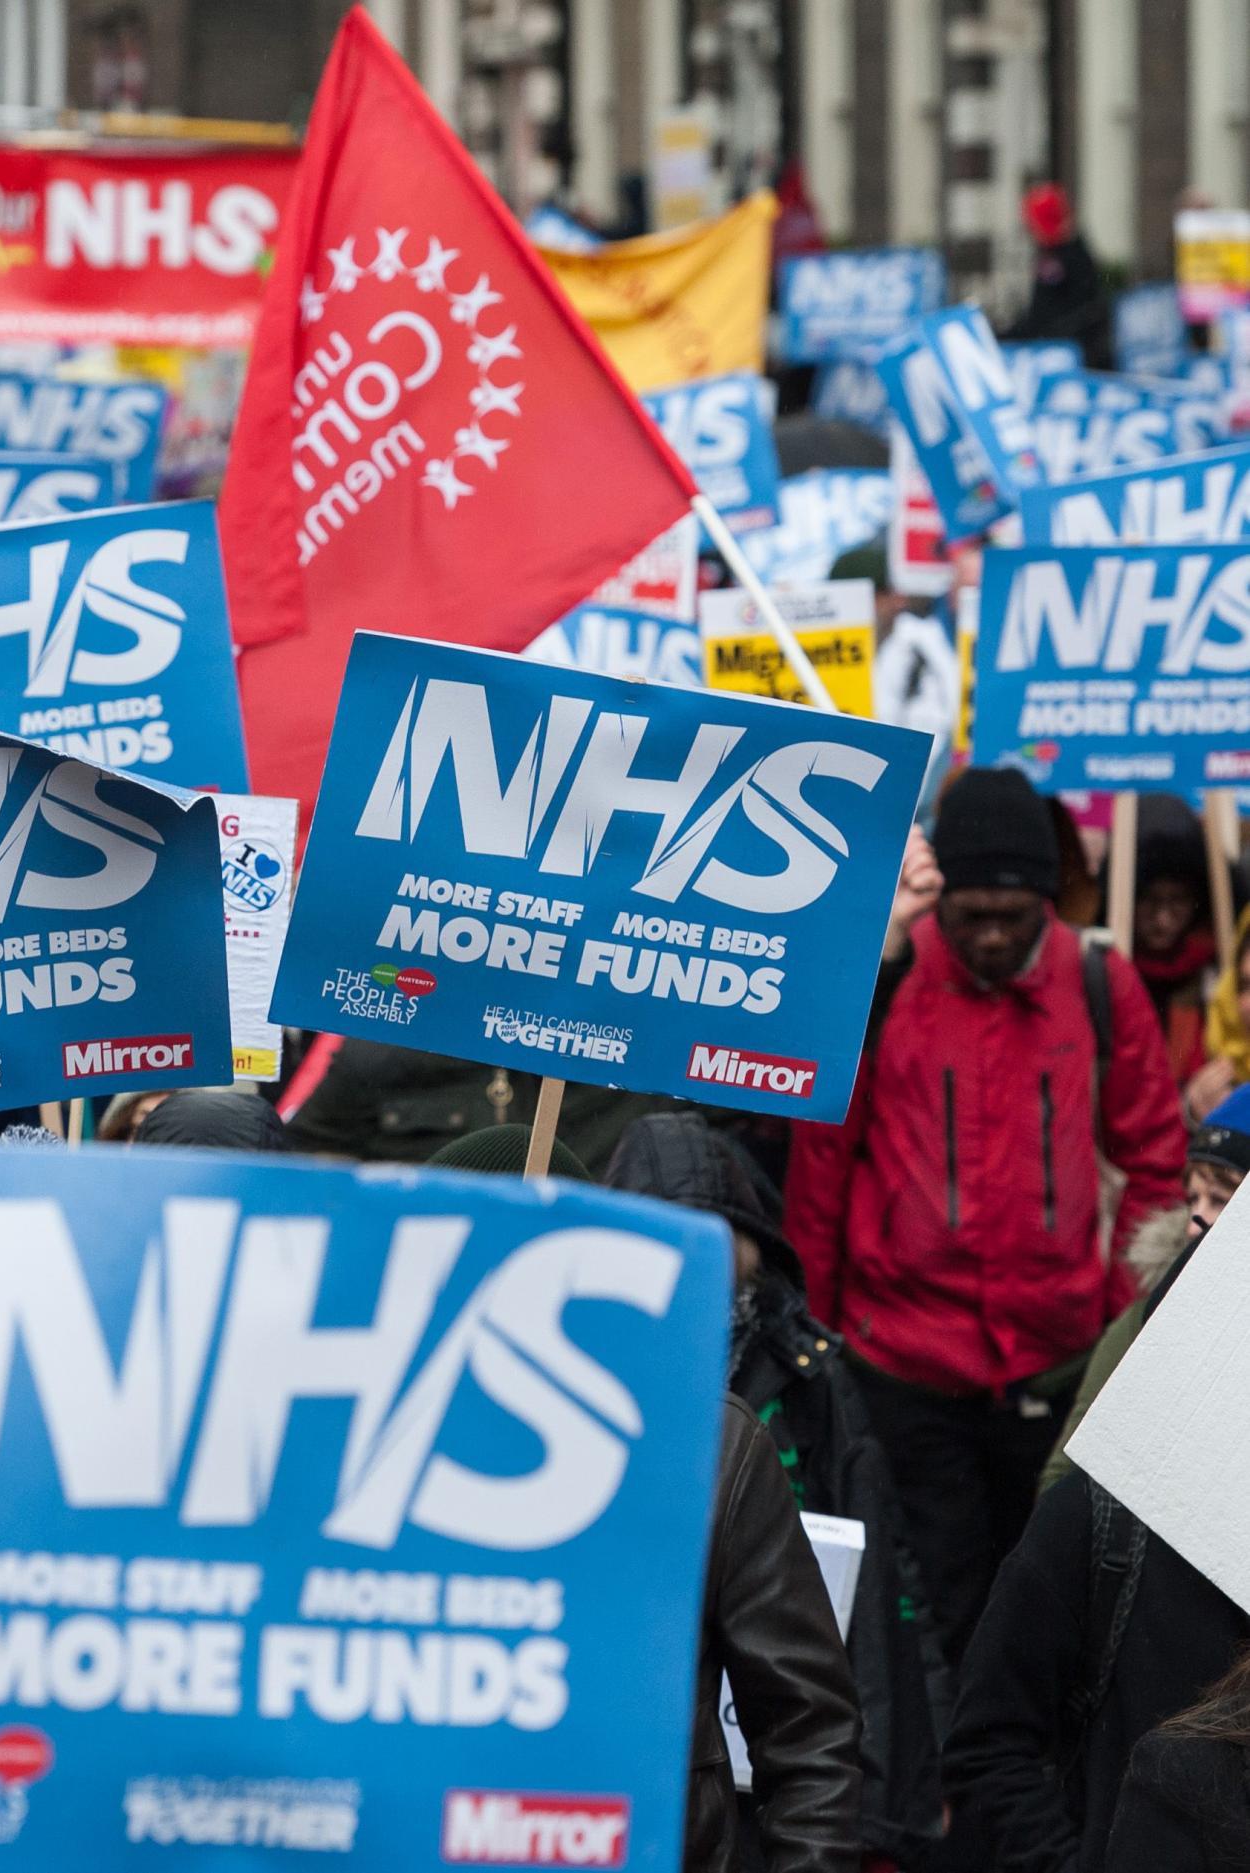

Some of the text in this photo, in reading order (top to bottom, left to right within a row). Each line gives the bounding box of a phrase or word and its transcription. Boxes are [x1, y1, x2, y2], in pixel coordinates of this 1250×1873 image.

[45, 178, 279, 274] NHS
[20, 703, 95, 737] MORE
[98, 694, 164, 725] BEDS
[1017, 700, 1129, 737] MORE
[355, 674, 889, 914] NHS
[220, 815, 241, 837] G
[235, 843, 257, 869] I
[222, 864, 276, 912] NHS
[397, 872, 788, 961] MORE STAFF MORE BEDS
[49, 927, 128, 956] BEDS
[376, 903, 785, 1015] MORE FUNDS
[336, 968, 372, 989] THE
[397, 974, 435, 988] AUSTERITY
[339, 1000, 417, 1026] ASSEMBLY
[485, 1004, 634, 1043] HEALTH CAMPAIGNS
[65, 1038, 192, 1078] Mirror
[482, 1014, 629, 1065] TOGETHER
[689, 1045, 813, 1094] Mirror
[124, 1557, 262, 1615] STAFF
[300, 1569, 440, 1624] MORE
[444, 1576, 565, 1631] BEDS
[257, 1624, 570, 1731] FUNDS
[126, 1796, 356, 1851] TOGETHER
[446, 1793, 626, 1866] Mirror
